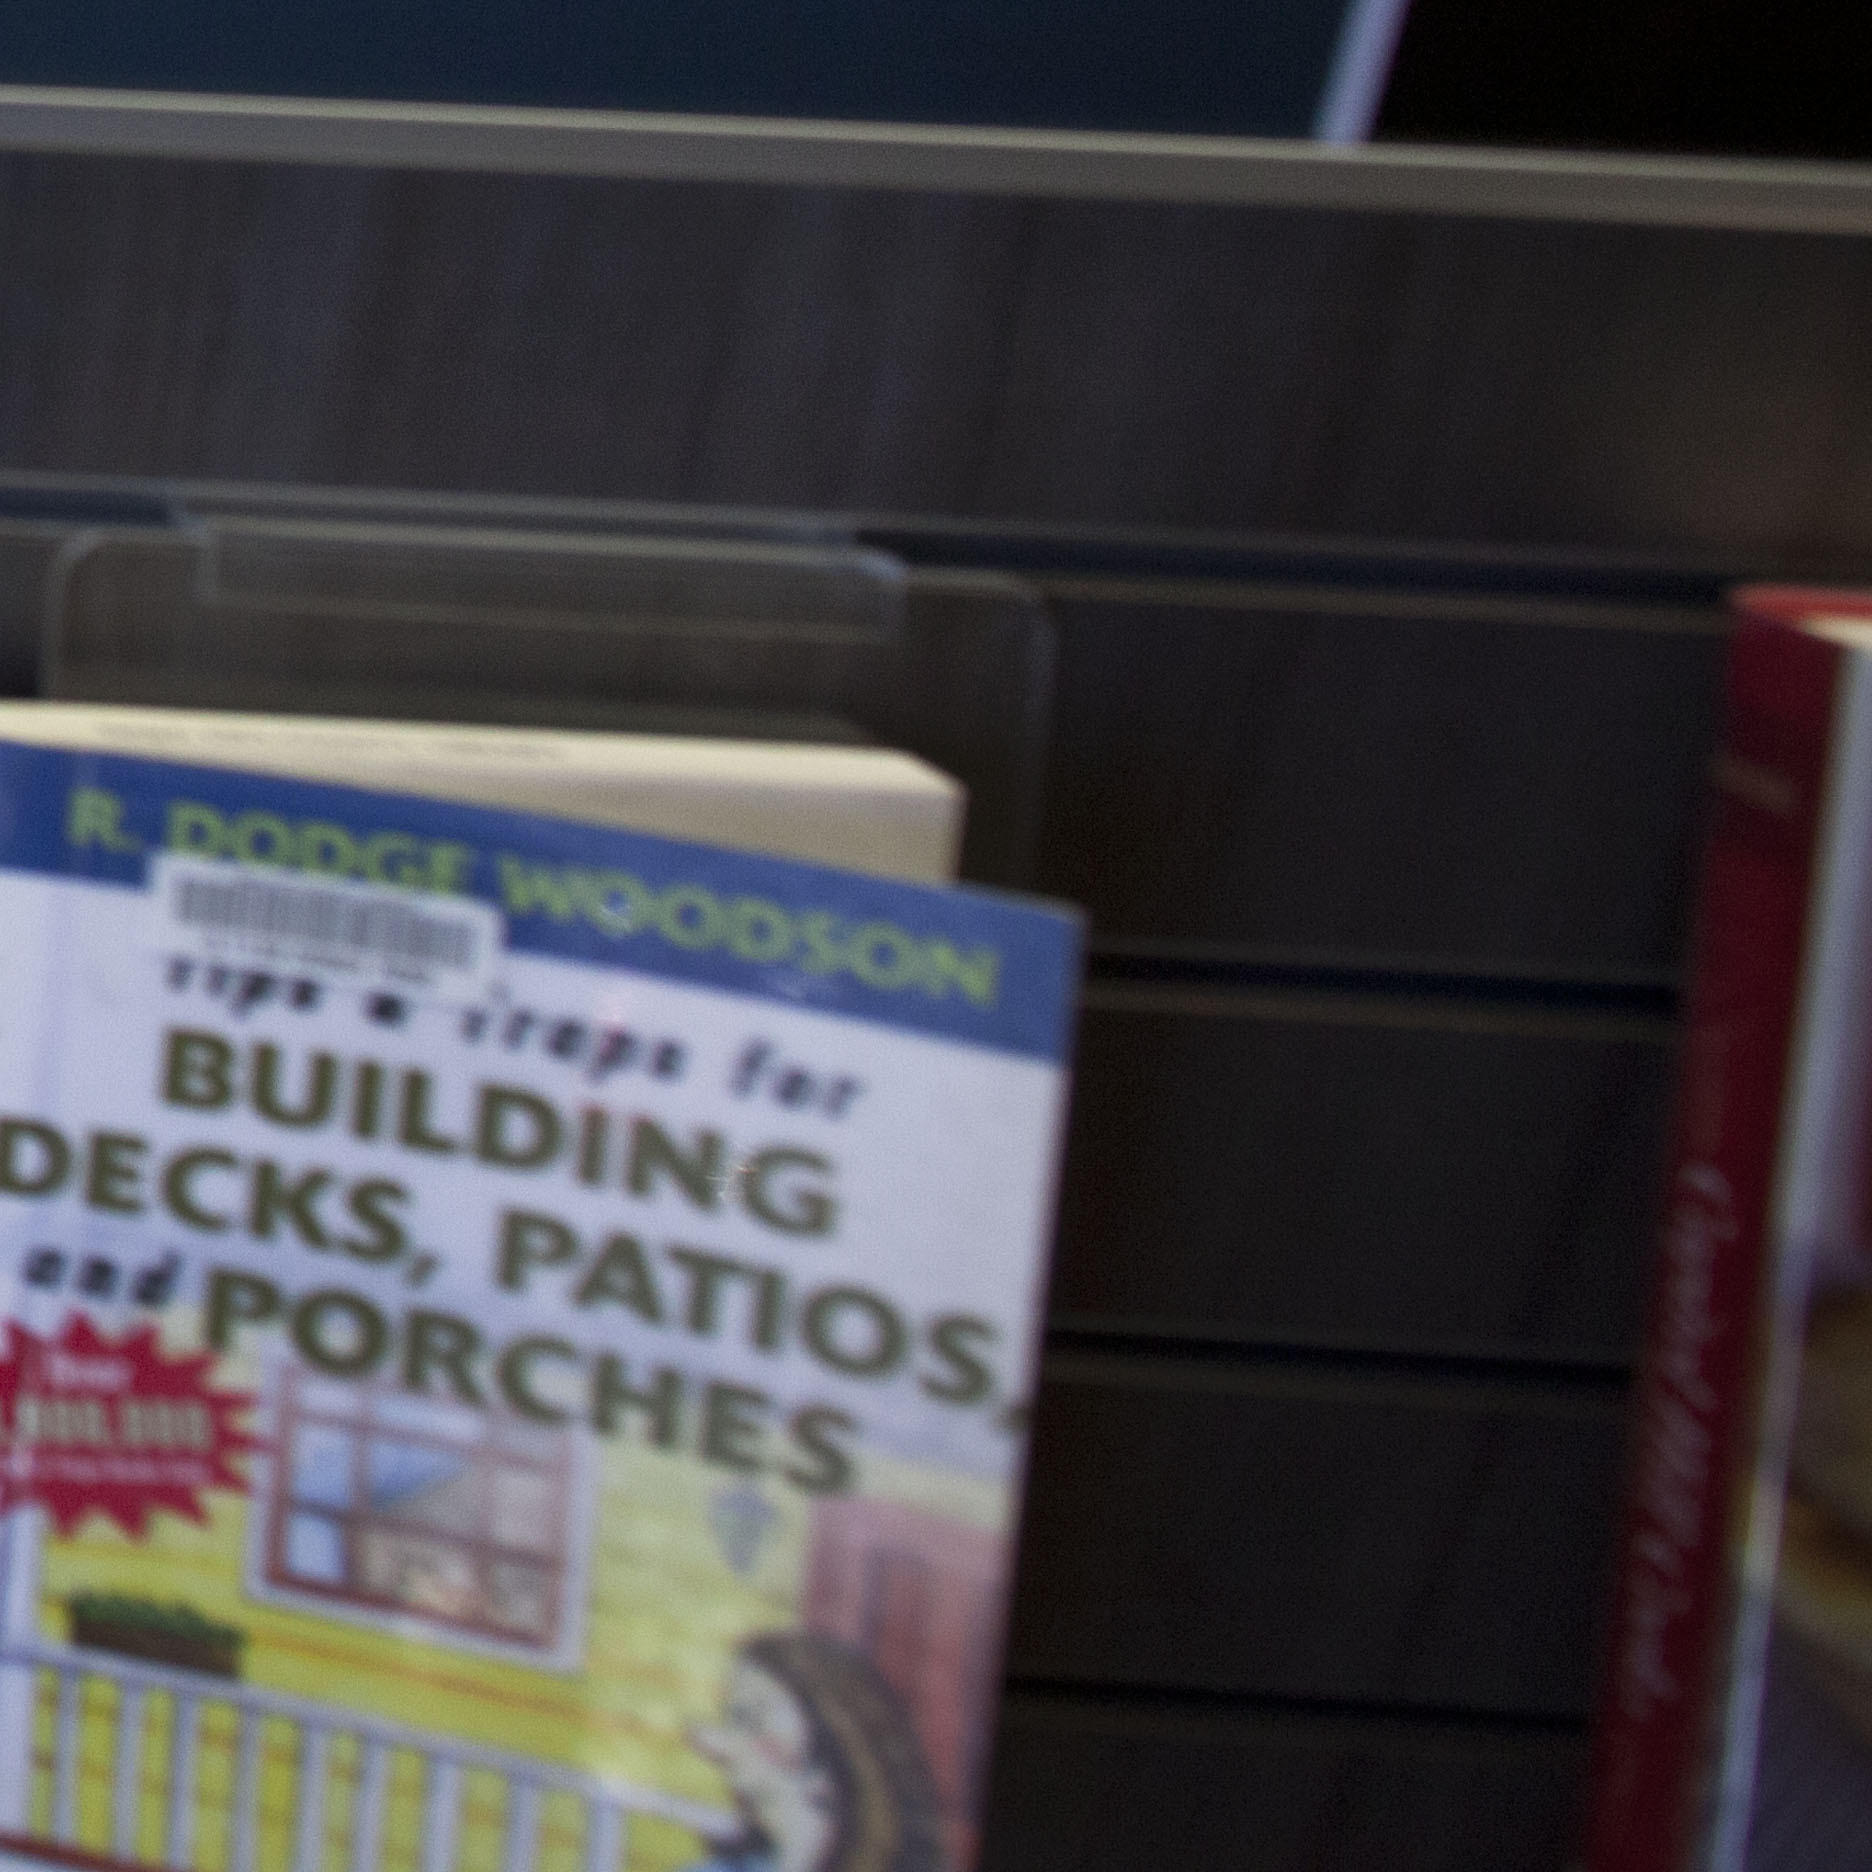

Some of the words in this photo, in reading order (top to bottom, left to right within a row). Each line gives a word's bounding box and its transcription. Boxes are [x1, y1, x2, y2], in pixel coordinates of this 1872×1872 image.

[65, 782, 144, 854] R.
[165, 796, 469, 896] DODGE
[496, 853, 1001, 1008] WOODSON
[153, 1019, 840, 1243] BUILDING
[20, 1244, 181, 1311] and
[198, 1262, 859, 1502] PORCHES
[491, 1203, 1032, 1436] PATIOS,
